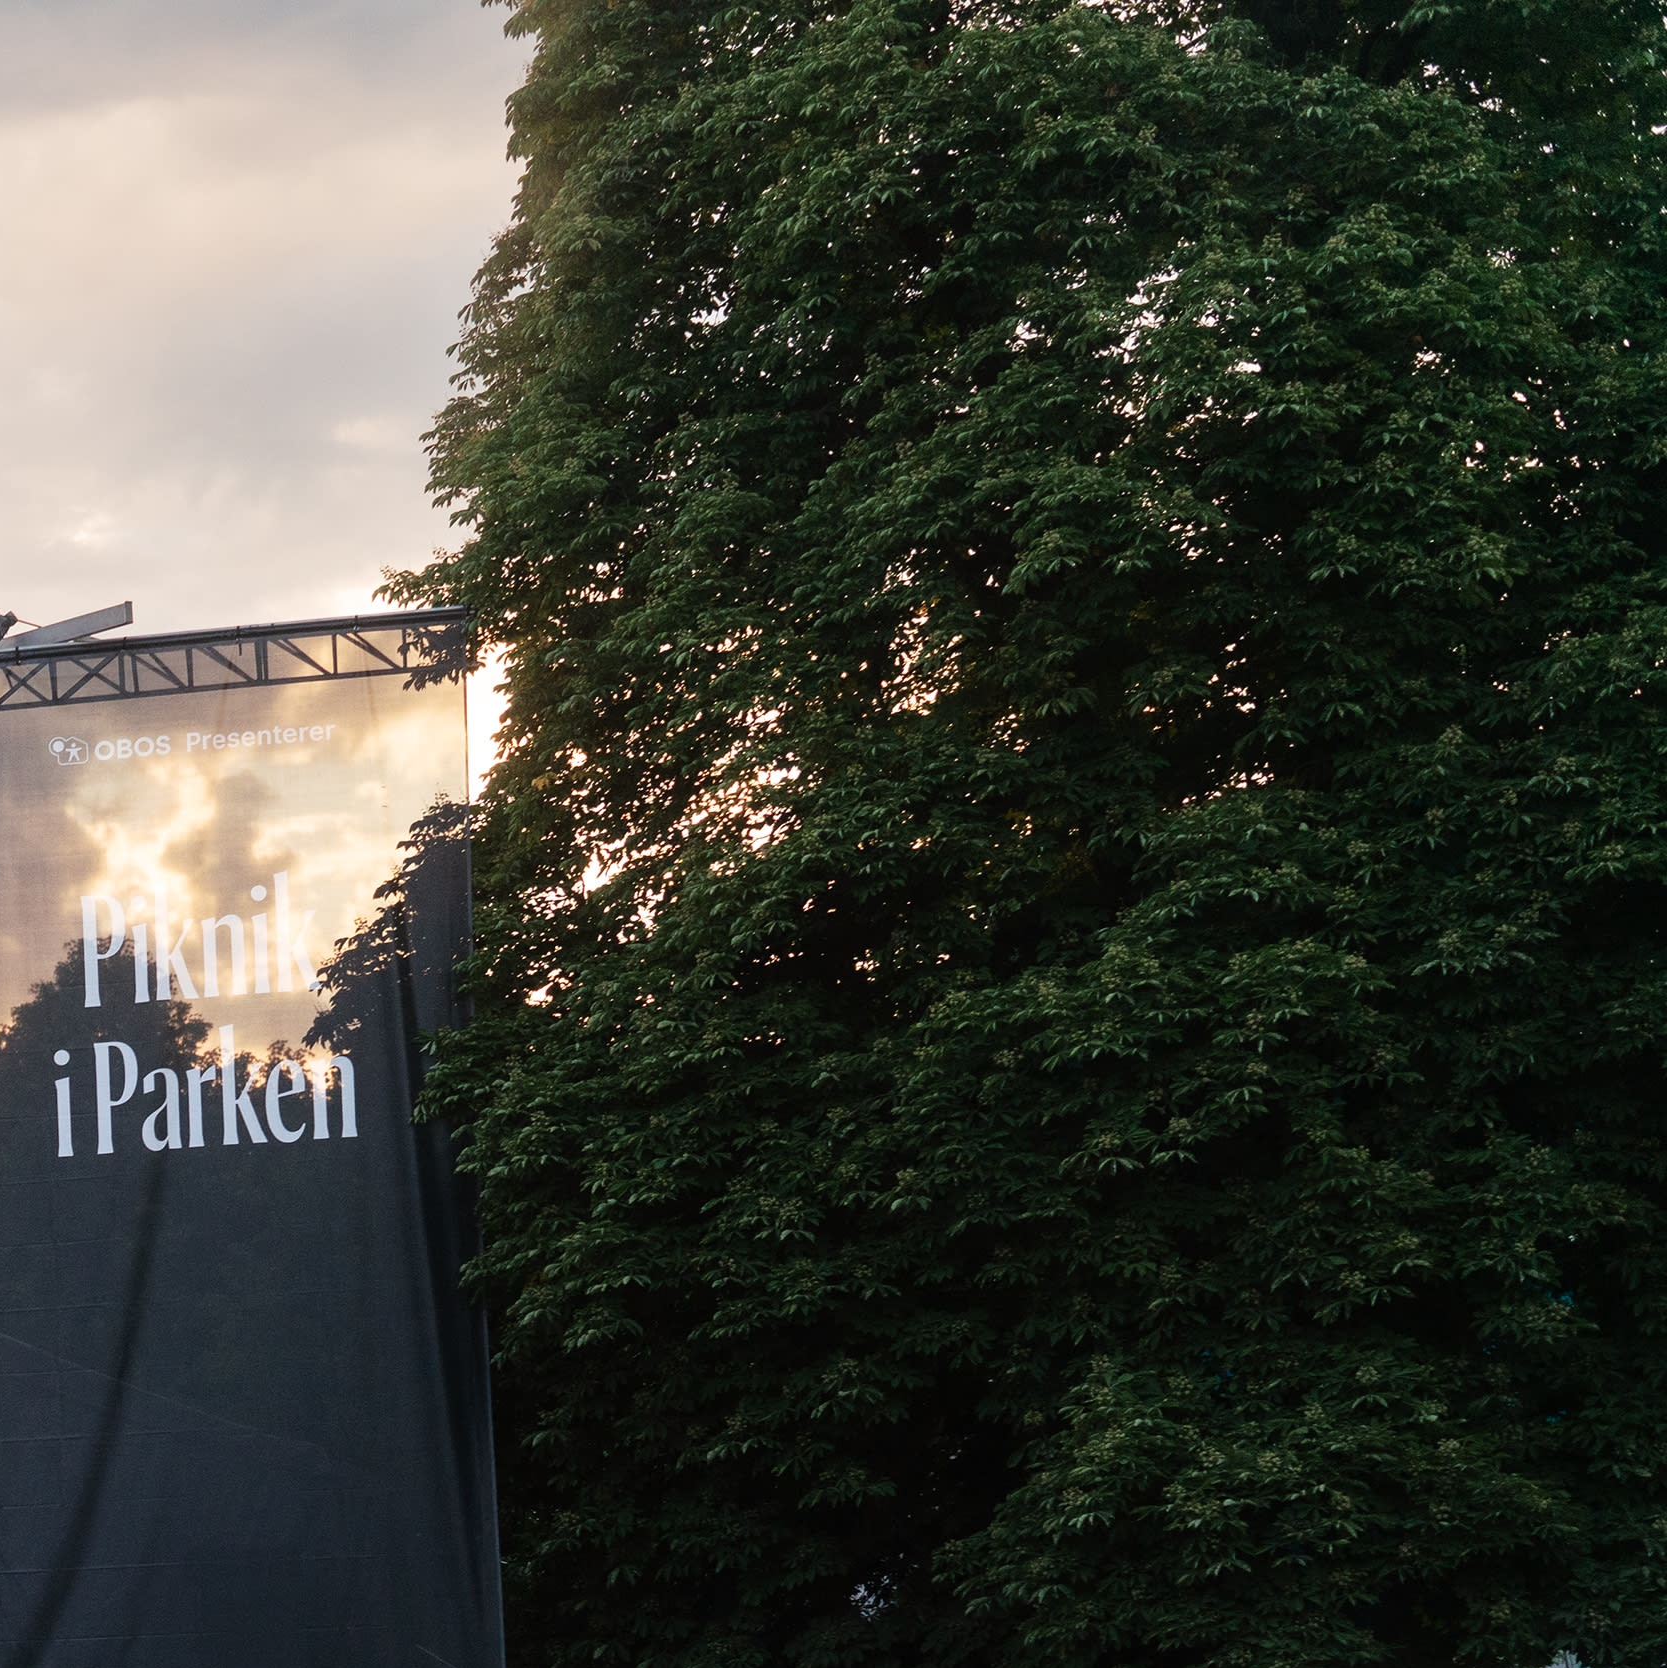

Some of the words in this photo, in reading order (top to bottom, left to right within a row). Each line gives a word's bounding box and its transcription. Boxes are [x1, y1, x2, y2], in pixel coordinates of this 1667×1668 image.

[94, 736, 171, 761] OBOS
[186, 724, 336, 752] Presenterer
[80, 870, 323, 1008] Piknik
[53, 1049, 74, 1157] i
[93, 1024, 358, 1155] Parken
